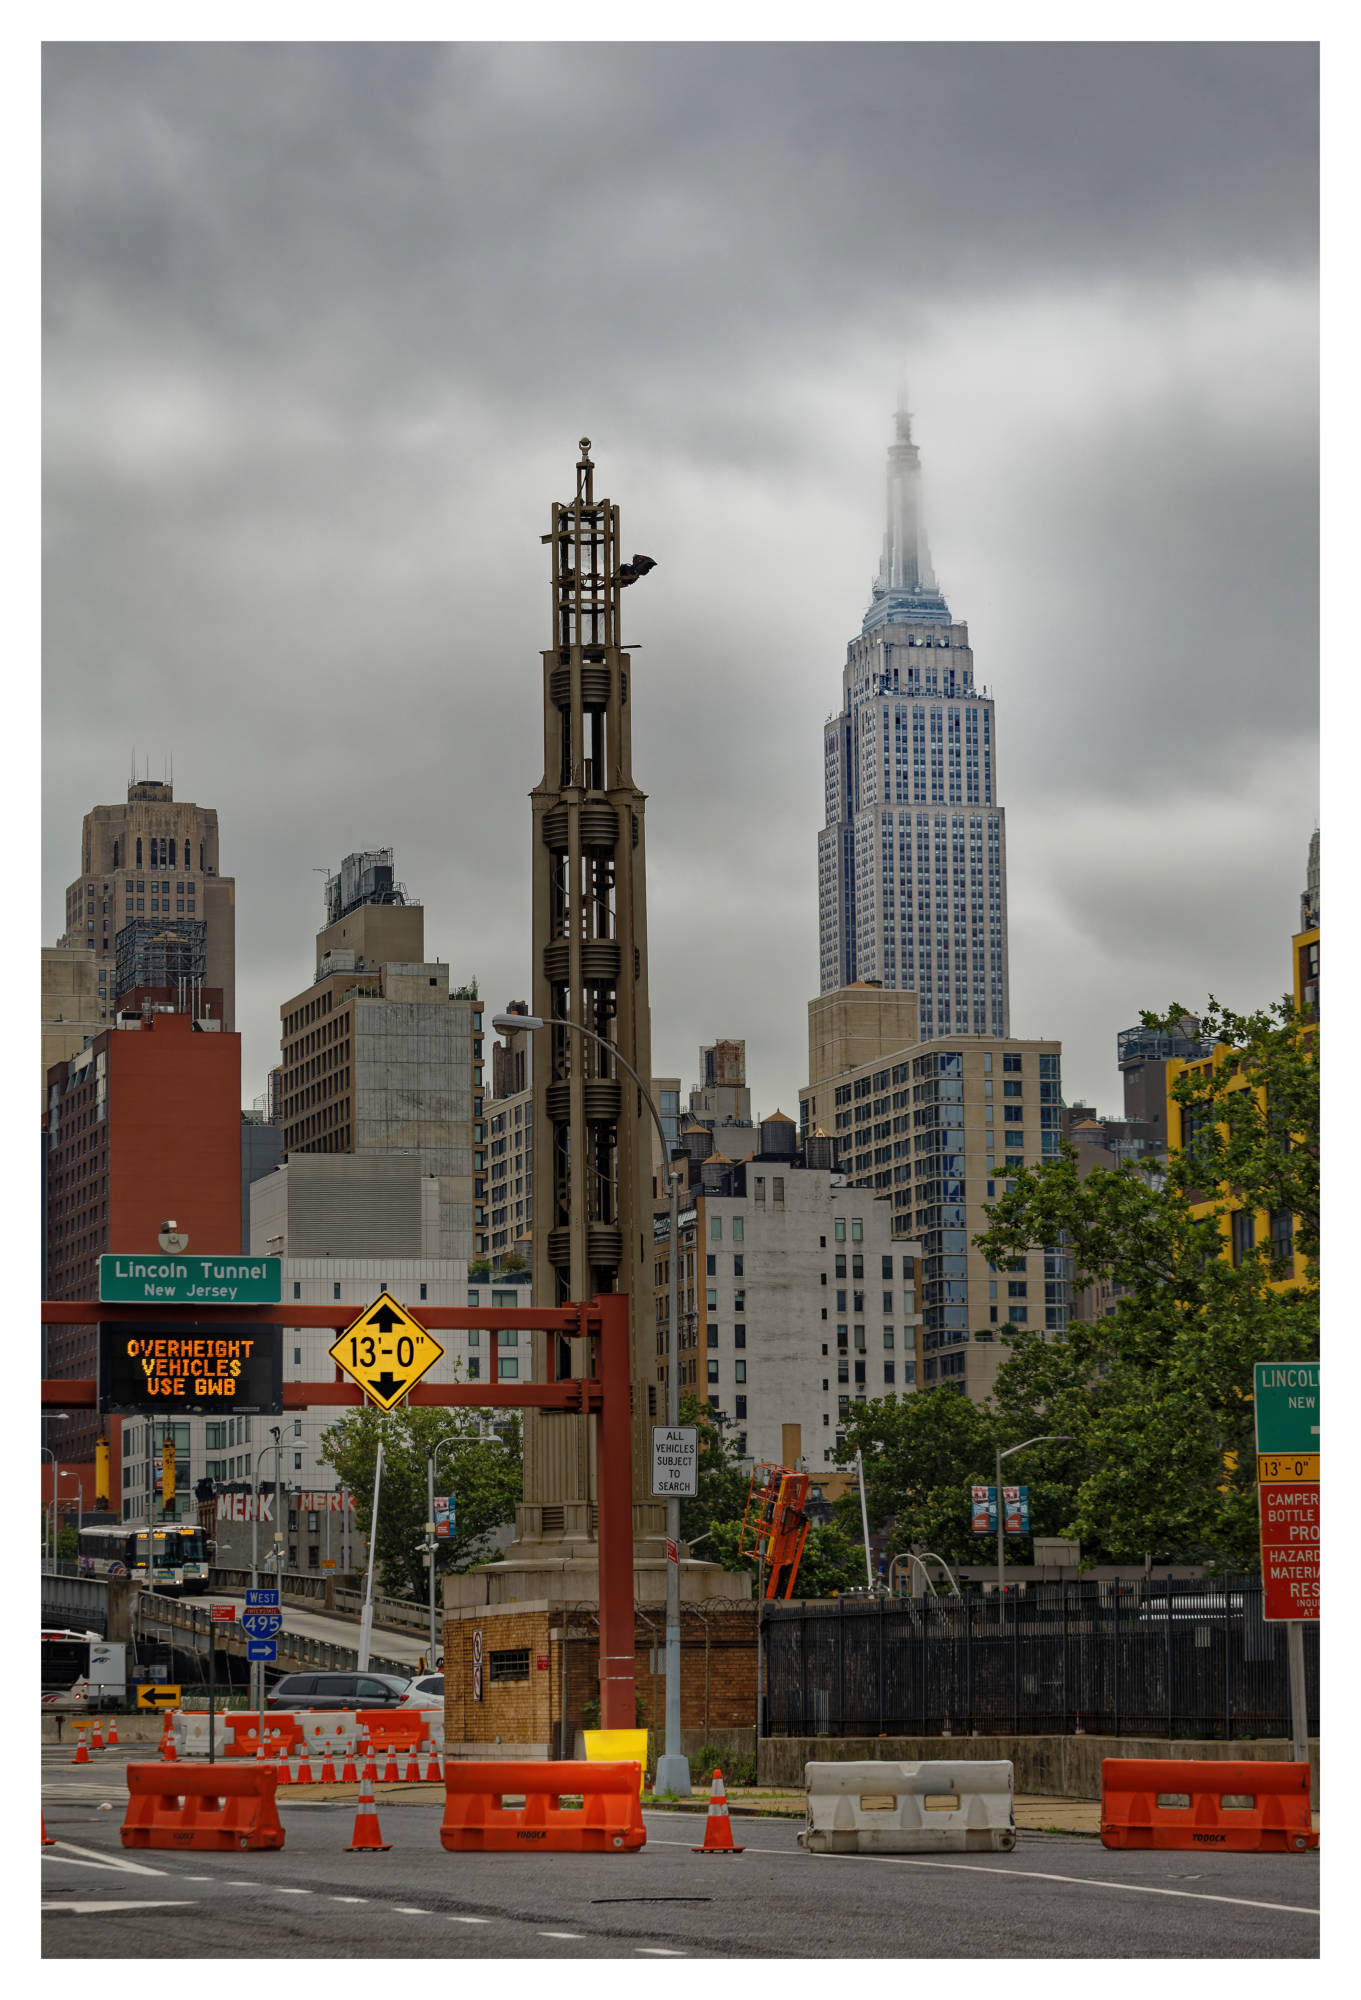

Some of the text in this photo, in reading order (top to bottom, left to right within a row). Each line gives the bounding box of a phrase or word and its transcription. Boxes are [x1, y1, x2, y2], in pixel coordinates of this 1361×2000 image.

[115, 1261, 267, 1279] Lincoln Tunnel
[144, 1283, 238, 1300] New Jersey
[127, 1339, 254, 1358] OVERHEIGHT
[142, 1358, 242, 1377] VEHICLES
[1262, 1369, 1320, 1388] LINCOL
[147, 1378, 236, 1396] USE GWB
[1289, 1397, 1315, 1408] NEW
[666, 1432, 684, 1440] ALL
[655, 1443, 695, 1454] VEHICLES
[657, 1456, 692, 1467] SUBJECT
[669, 1469, 681, 1479] TO
[658, 1481, 691, 1492] SEARCH
[1268, 1509, 1315, 1522] BOTTLE
[249, 1591, 276, 1603] WEST
[245, 1616, 280, 1632] 495
